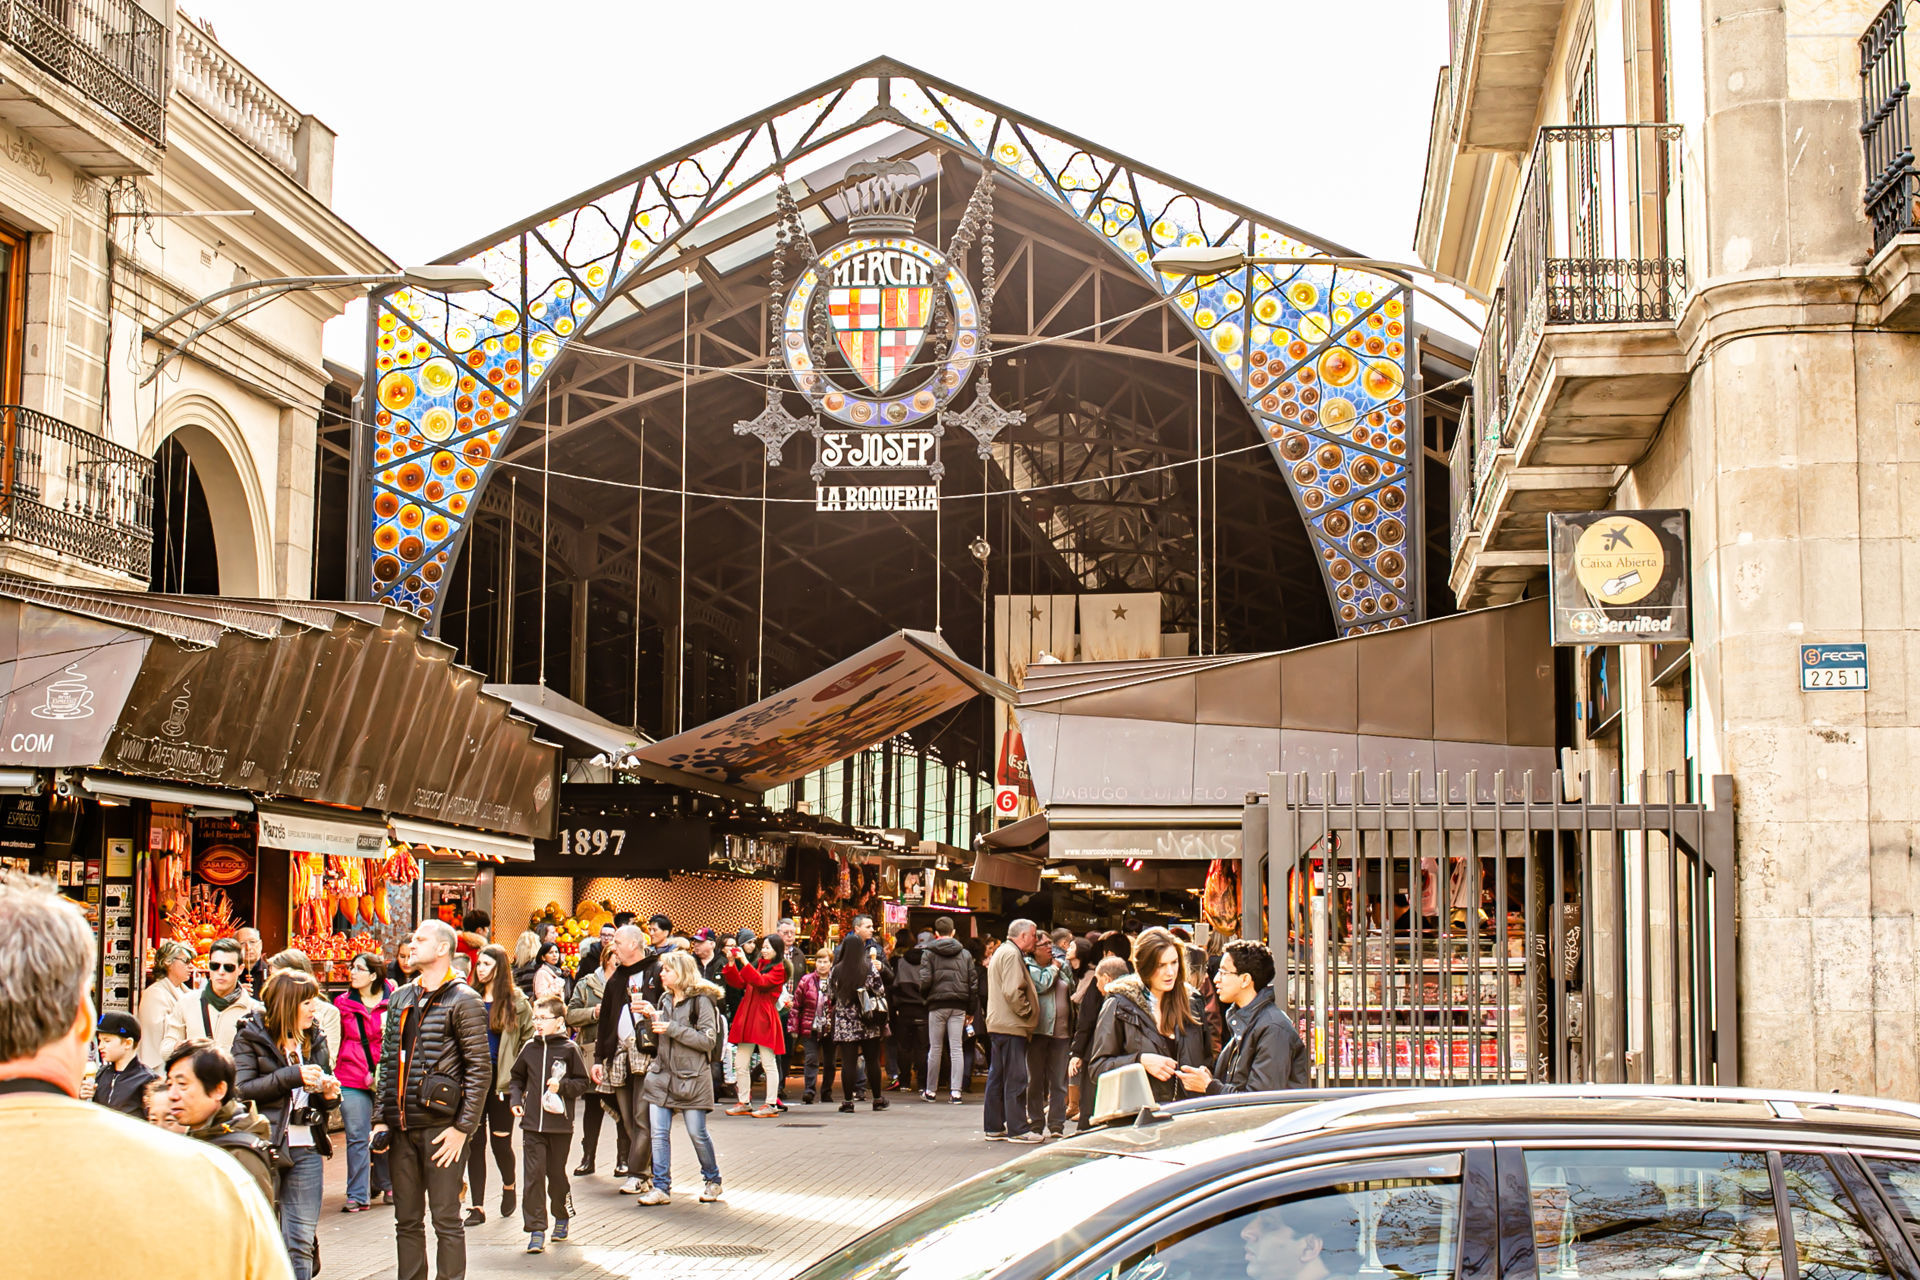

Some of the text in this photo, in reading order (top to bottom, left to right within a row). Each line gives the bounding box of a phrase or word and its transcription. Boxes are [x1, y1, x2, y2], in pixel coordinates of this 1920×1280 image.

[833, 252, 932, 286] MERCAT
[847, 433, 934, 467] JOSEP
[816, 485, 938, 511] LA BOQUERIA
[1580, 556, 1657, 569] Caixa Abierta
[1598, 616, 1672, 633] ServiRed
[1821, 651, 1865, 661] FECSA
[1811, 670, 1859, 686] 2251
[1002, 794, 1013, 809] 6
[1057, 787, 1128, 800] JABUGO
[7, 812, 41, 827] ESPRESSO
[559, 828, 627, 856] 1897
